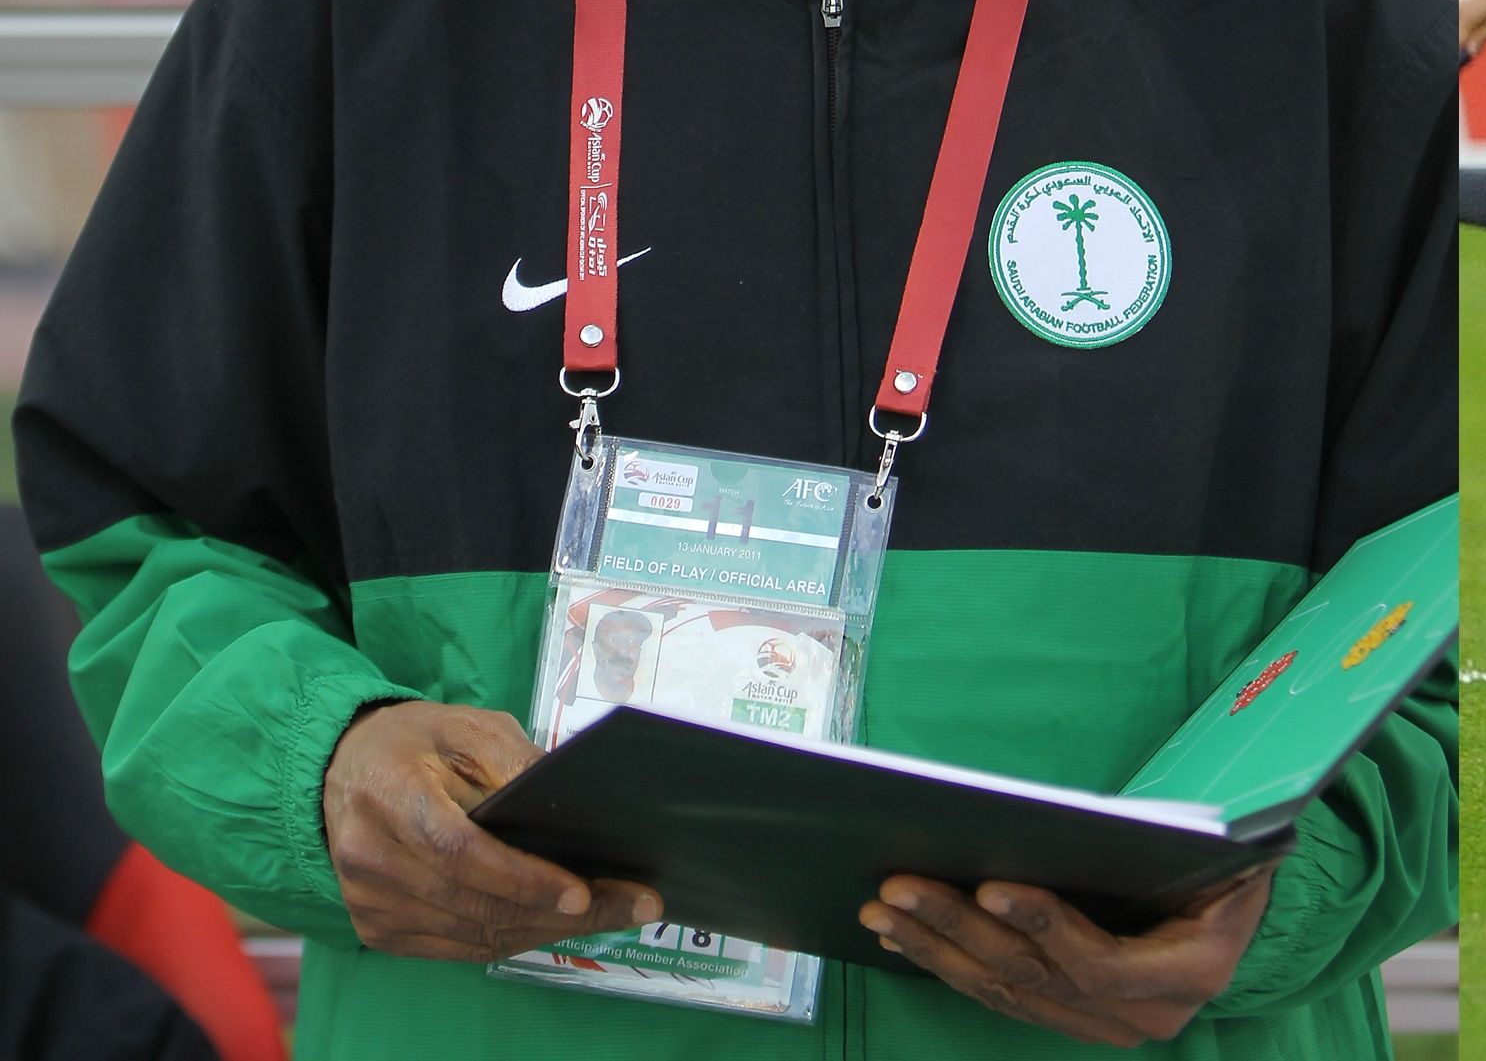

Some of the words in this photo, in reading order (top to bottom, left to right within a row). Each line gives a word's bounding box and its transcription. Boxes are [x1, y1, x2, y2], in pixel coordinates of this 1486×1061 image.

[1006, 259, 1025, 297] SAUDI
[1021, 294, 1064, 330] ARABIAN
[1065, 315, 1124, 334] FOOTBALL
[1124, 254, 1158, 320] FEDERATION
[782, 478, 838, 502] AFC
[650, 496, 681, 509] 0029
[701, 496, 755, 545] 11
[677, 542, 688, 551] 13
[690, 543, 737, 557] JANUARY
[739, 549, 760, 560] 2011
[603, 555, 644, 572] FIELD
[647, 561, 668, 574] OF
[671, 564, 708, 580] PLAY
[718, 570, 782, 590] OFFICIAL
[786, 579, 826, 595] AREA
[742, 681, 775, 697] Asian
[777, 685, 798, 704] Cup
[746, 704, 790, 728] TM2
[554, 939, 622, 959] articipating
[626, 948, 675, 965] Member
[677, 957, 749, 978] Association
